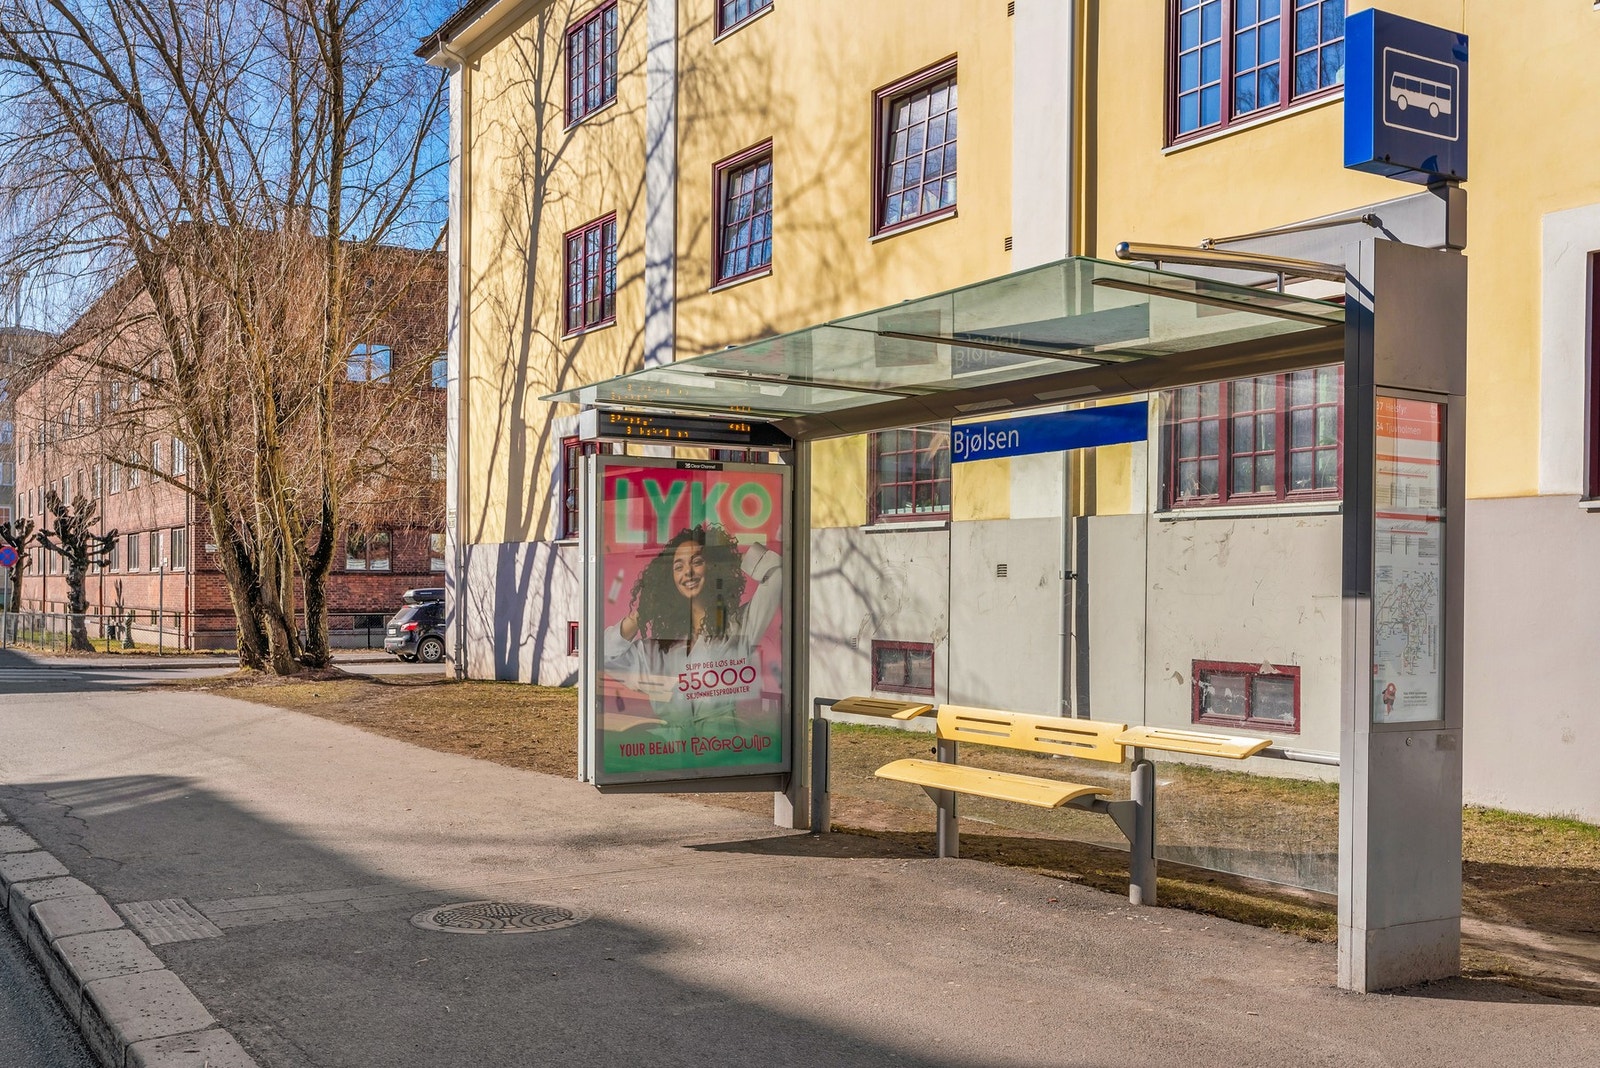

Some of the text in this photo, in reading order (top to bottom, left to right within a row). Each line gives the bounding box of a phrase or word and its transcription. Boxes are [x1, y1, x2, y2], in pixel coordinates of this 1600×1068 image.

[954, 426, 1019, 460] Bjølsen
[615, 478, 772, 545] LYKO
[685, 657, 746, 671] SLIPP DEG LØS BLANT
[678, 665, 756, 692] 55000
[686, 685, 750, 700] SKJØNNHETSPRODUKTER
[619, 734, 771, 757] YOUR BEAUTY PLAYGROUND
